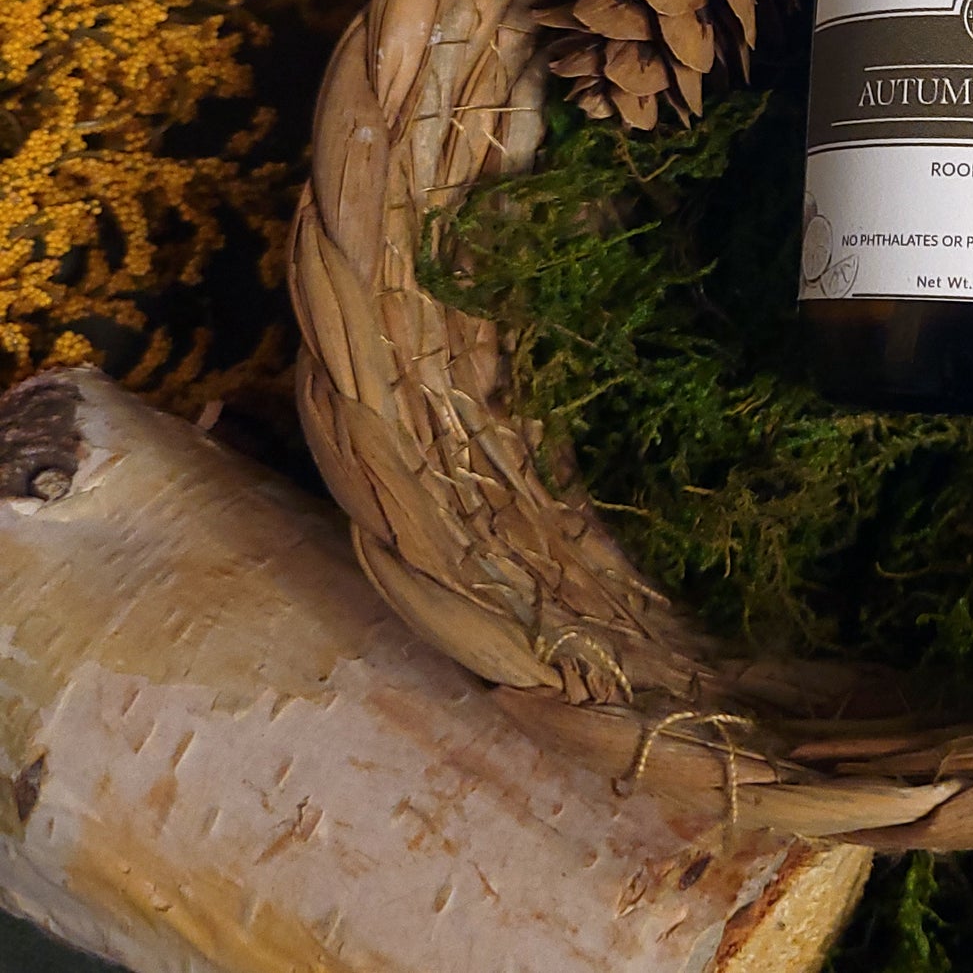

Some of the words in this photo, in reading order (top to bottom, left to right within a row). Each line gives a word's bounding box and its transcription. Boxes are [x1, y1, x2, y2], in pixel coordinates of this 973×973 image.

[841, 234, 858, 247] NO
[860, 234, 938, 247] PHTHALATES
[942, 235, 963, 247] OR
[916, 275, 941, 288] Net
[947, 277, 972, 290] Wt.
